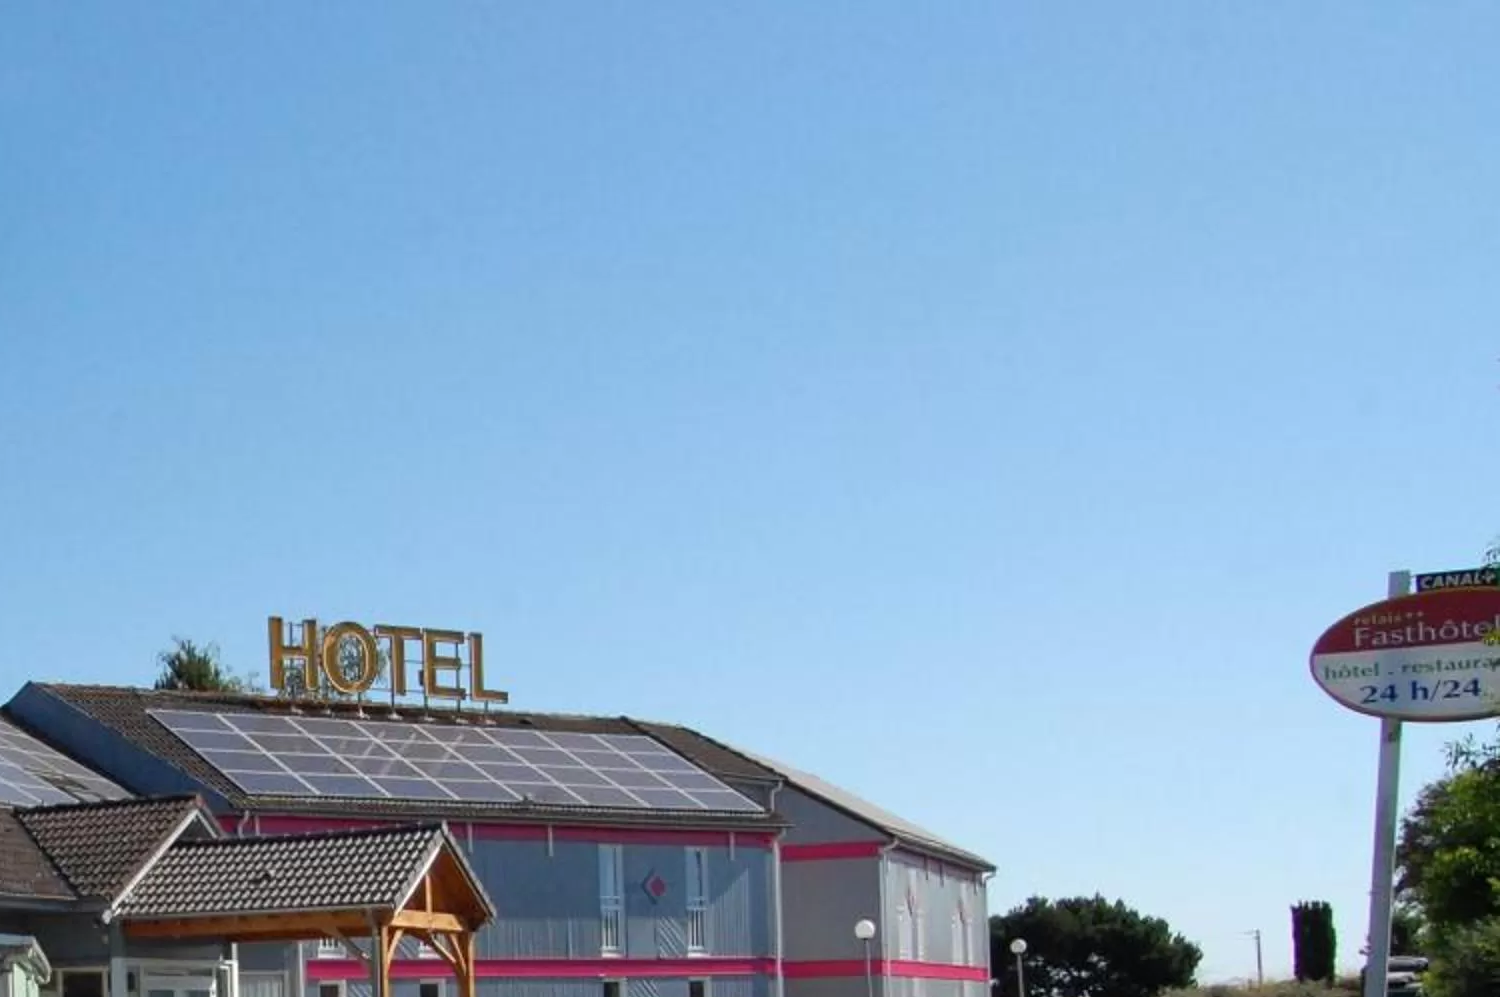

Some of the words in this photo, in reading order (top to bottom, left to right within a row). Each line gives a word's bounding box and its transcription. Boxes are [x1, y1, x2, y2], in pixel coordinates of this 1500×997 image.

[1420, 571, 1496, 589] CANAL+
[268, 616, 509, 704] HOTEL
[1324, 662, 1380, 681] hôtel
[1401, 657, 1500, 674] restaura
[1359, 684, 1398, 704] 24
[1410, 677, 1481, 702] h/24
